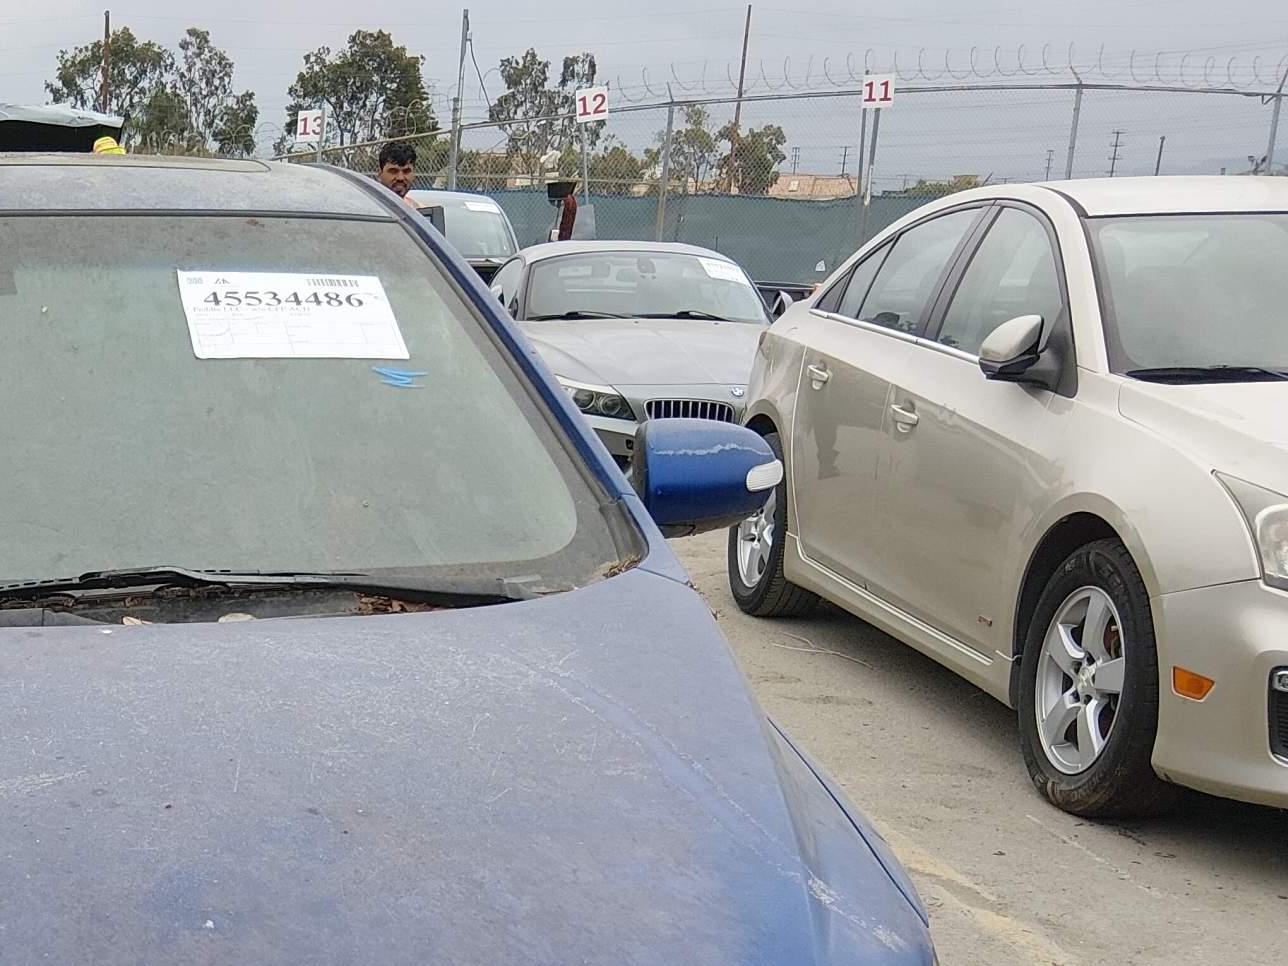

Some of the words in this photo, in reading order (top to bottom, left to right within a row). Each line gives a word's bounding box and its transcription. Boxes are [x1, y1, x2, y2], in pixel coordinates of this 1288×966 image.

[863, 80, 892, 102] 11
[578, 93, 607, 116] 12
[298, 116, 322, 136] 13
[203, 290, 364, 308] 45534486
